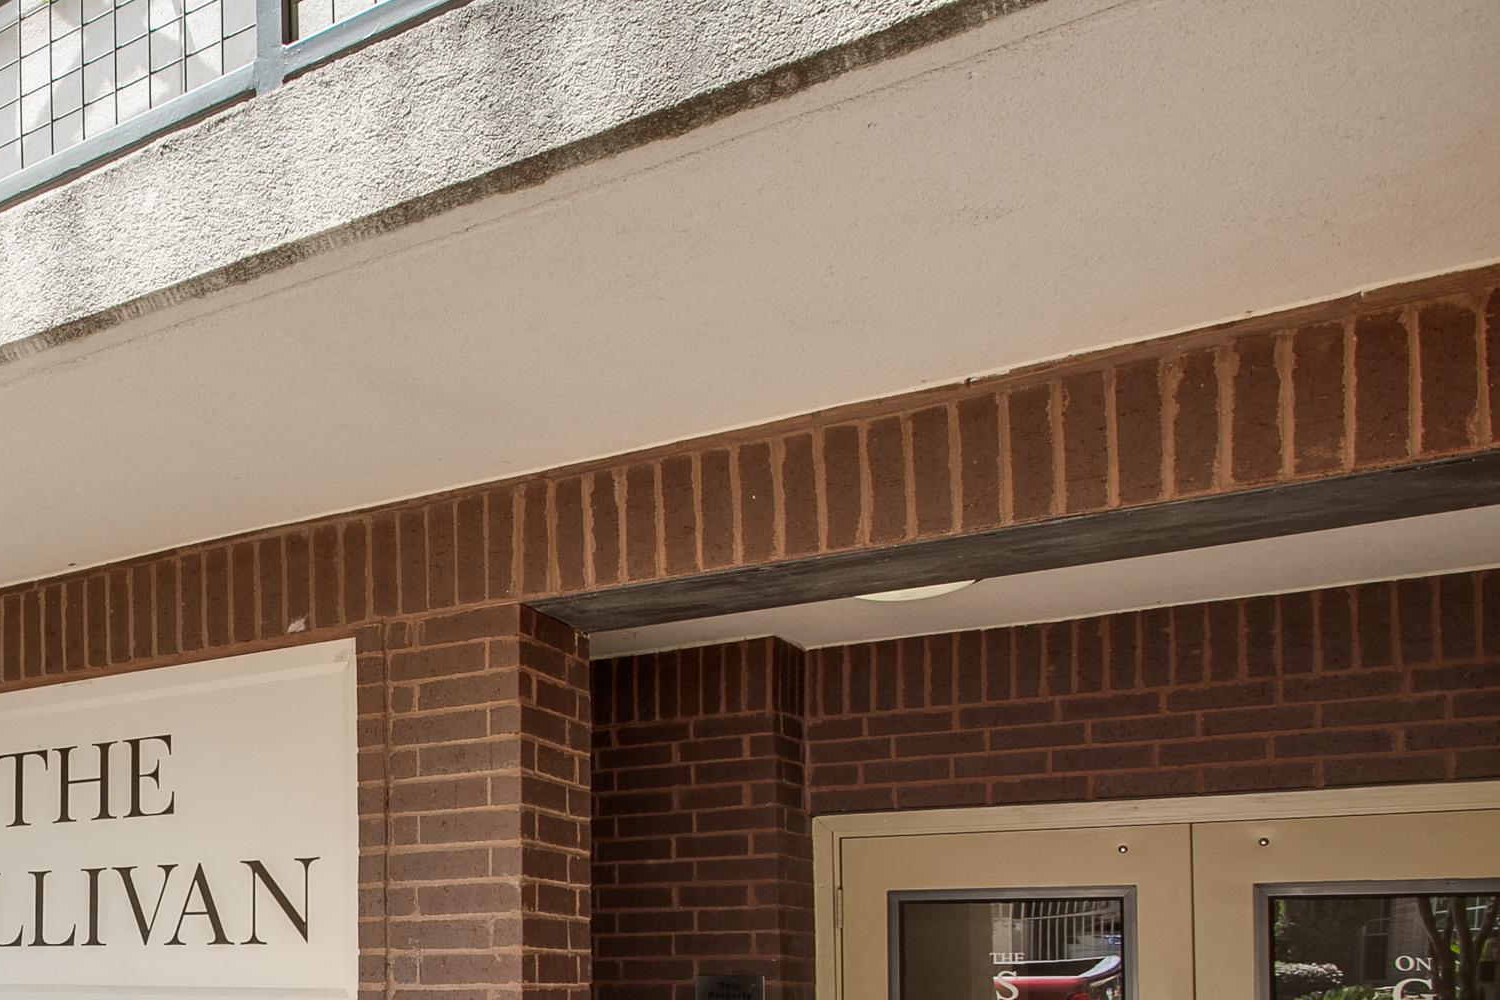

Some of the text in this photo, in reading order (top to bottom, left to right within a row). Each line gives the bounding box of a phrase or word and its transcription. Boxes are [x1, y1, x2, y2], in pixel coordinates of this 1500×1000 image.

[989, 952, 1025, 965] THE
[1394, 955, 1433, 972] ON
[718, 982, 741, 990] This
[708, 991, 753, 1000] Property
